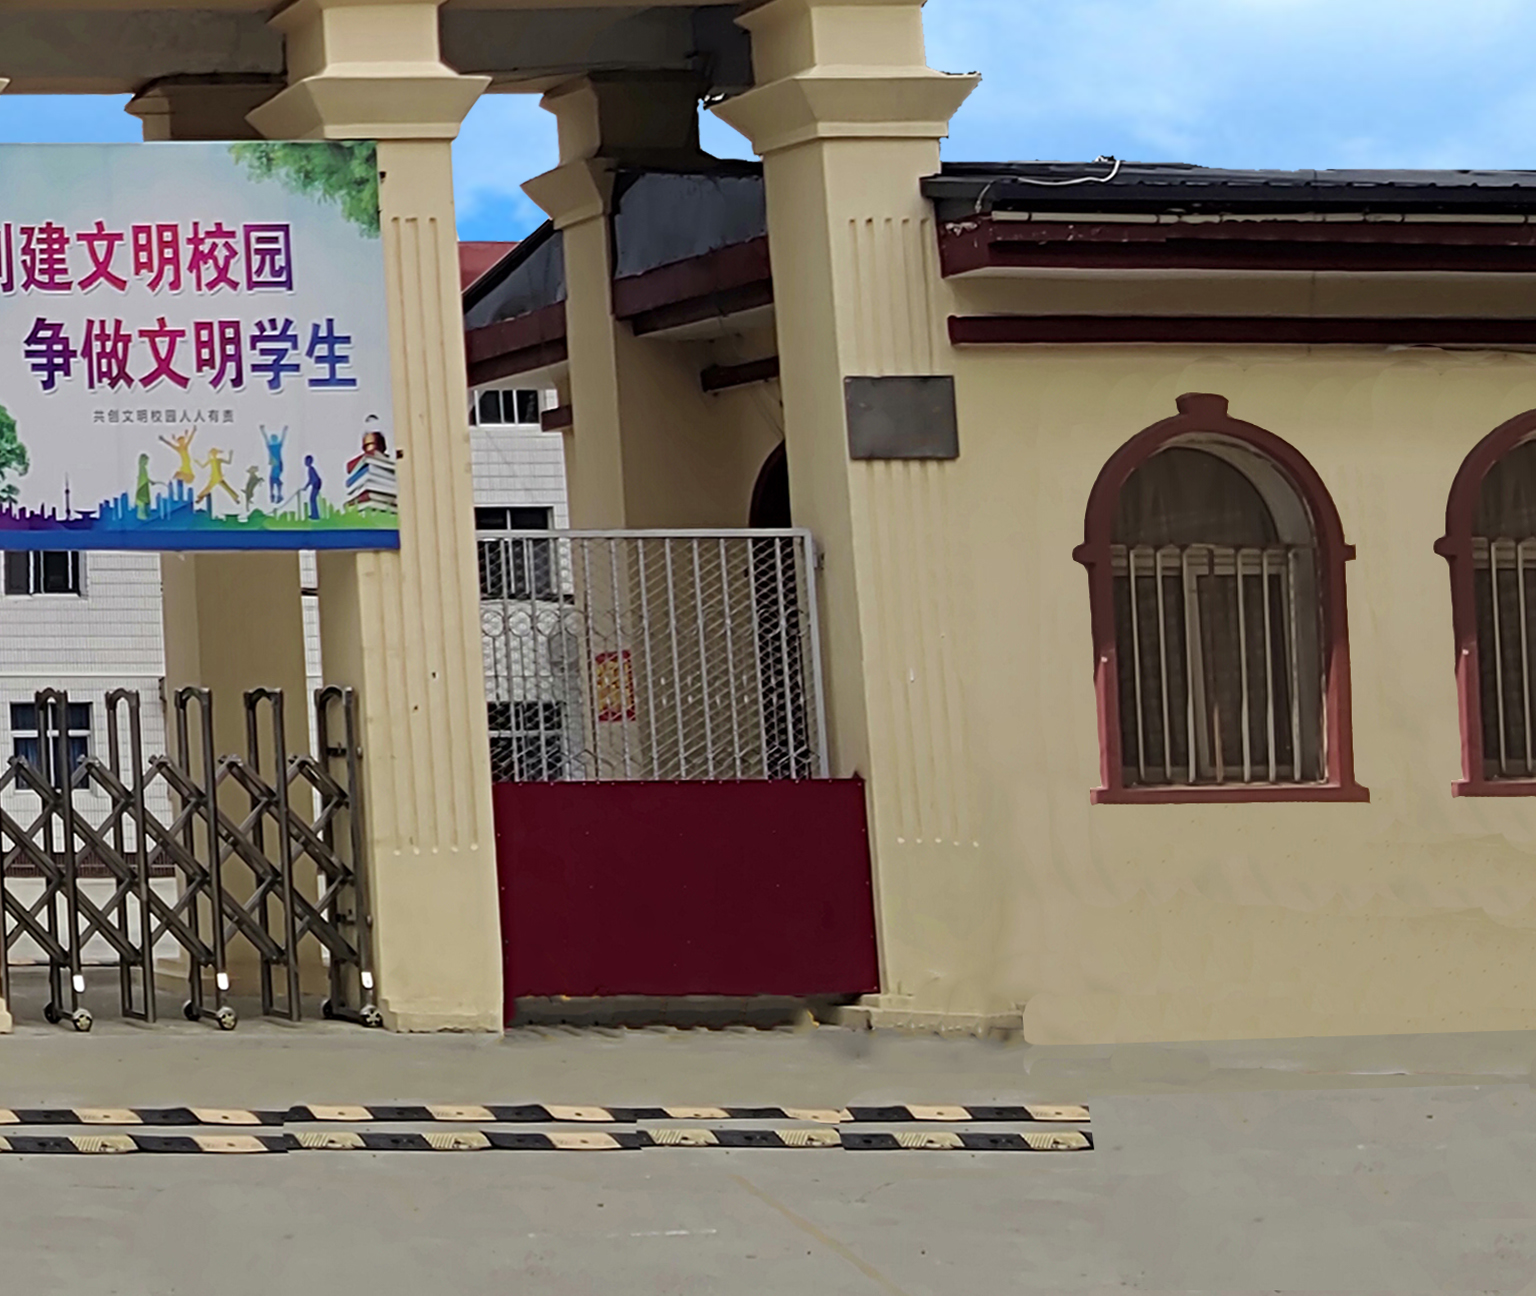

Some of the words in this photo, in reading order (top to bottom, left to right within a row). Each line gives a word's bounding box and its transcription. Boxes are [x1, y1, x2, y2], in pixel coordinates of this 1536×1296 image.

[23, 316, 358, 391] 争做文明学生
[93, 409, 234, 423] 共创文明校园人人有责
